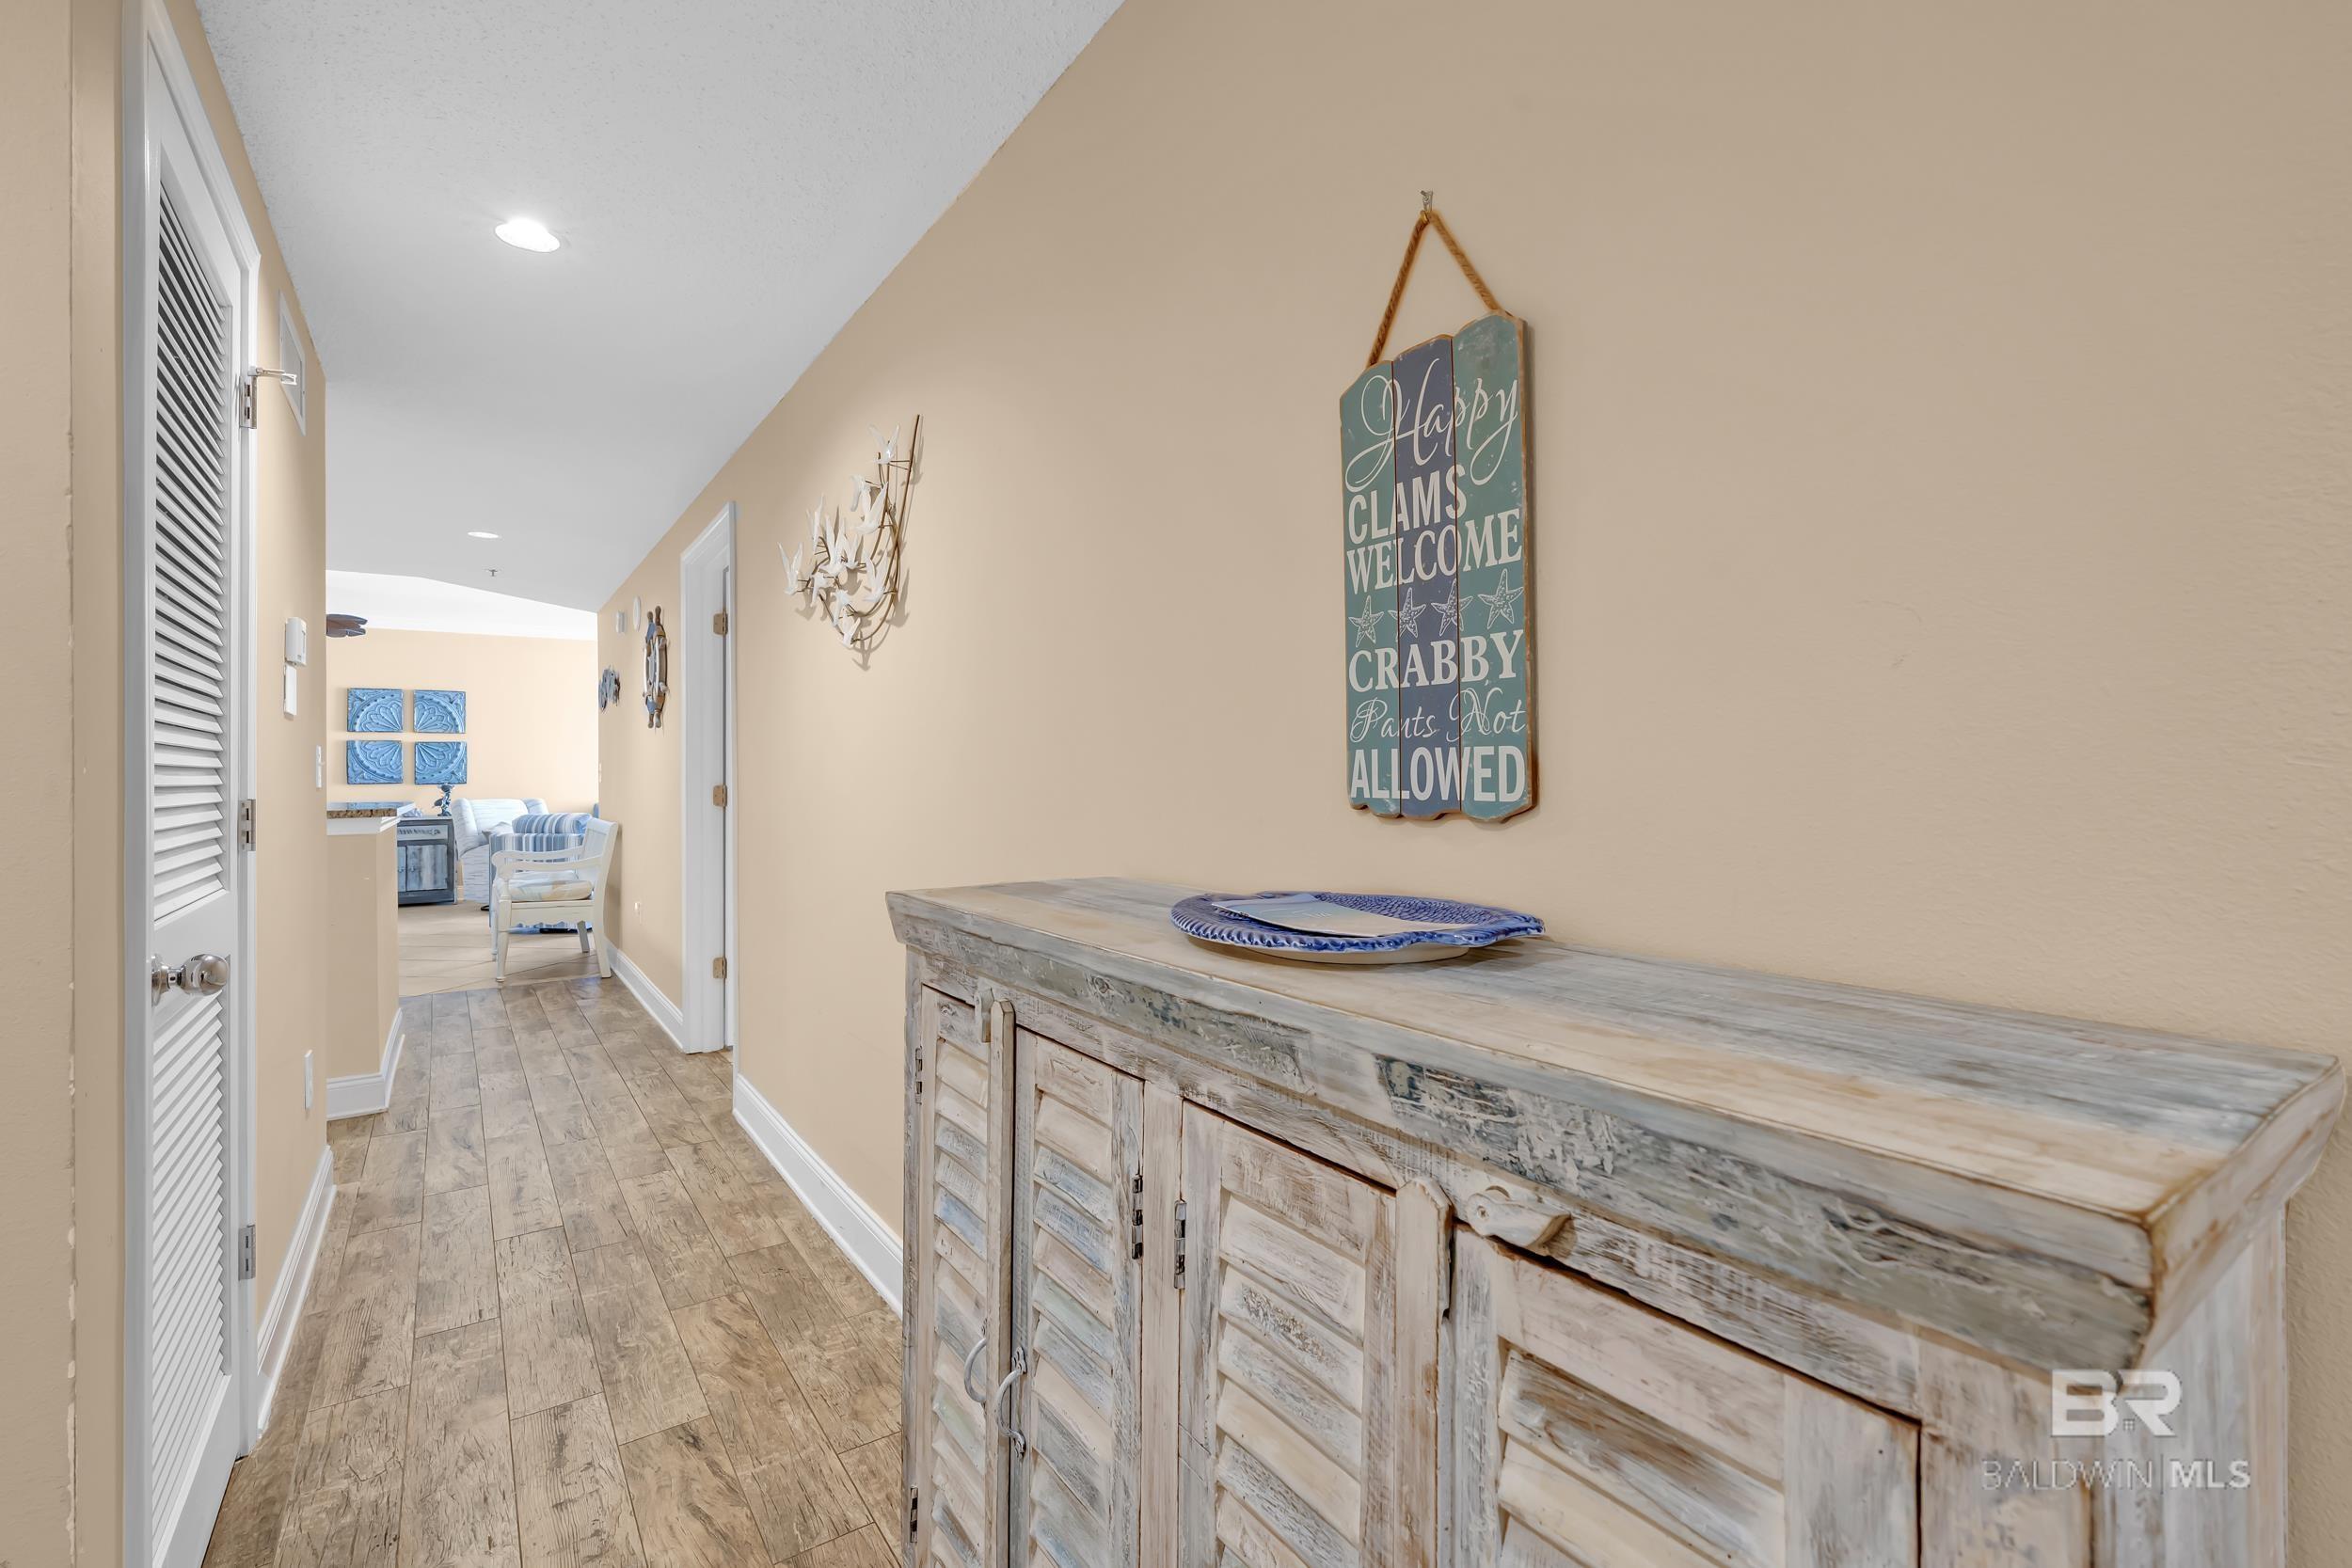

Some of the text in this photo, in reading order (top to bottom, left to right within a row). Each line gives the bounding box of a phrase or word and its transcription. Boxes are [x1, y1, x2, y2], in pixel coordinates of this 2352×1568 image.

[1344, 357, 1518, 492] Happy
[1348, 464, 1468, 545] CLAMS
[1346, 508, 1522, 594] WELCOME
[1348, 629, 1524, 692] CRABBY
[1349, 687, 1526, 742] Pants Not
[1350, 745, 1526, 802] ALLOWED
